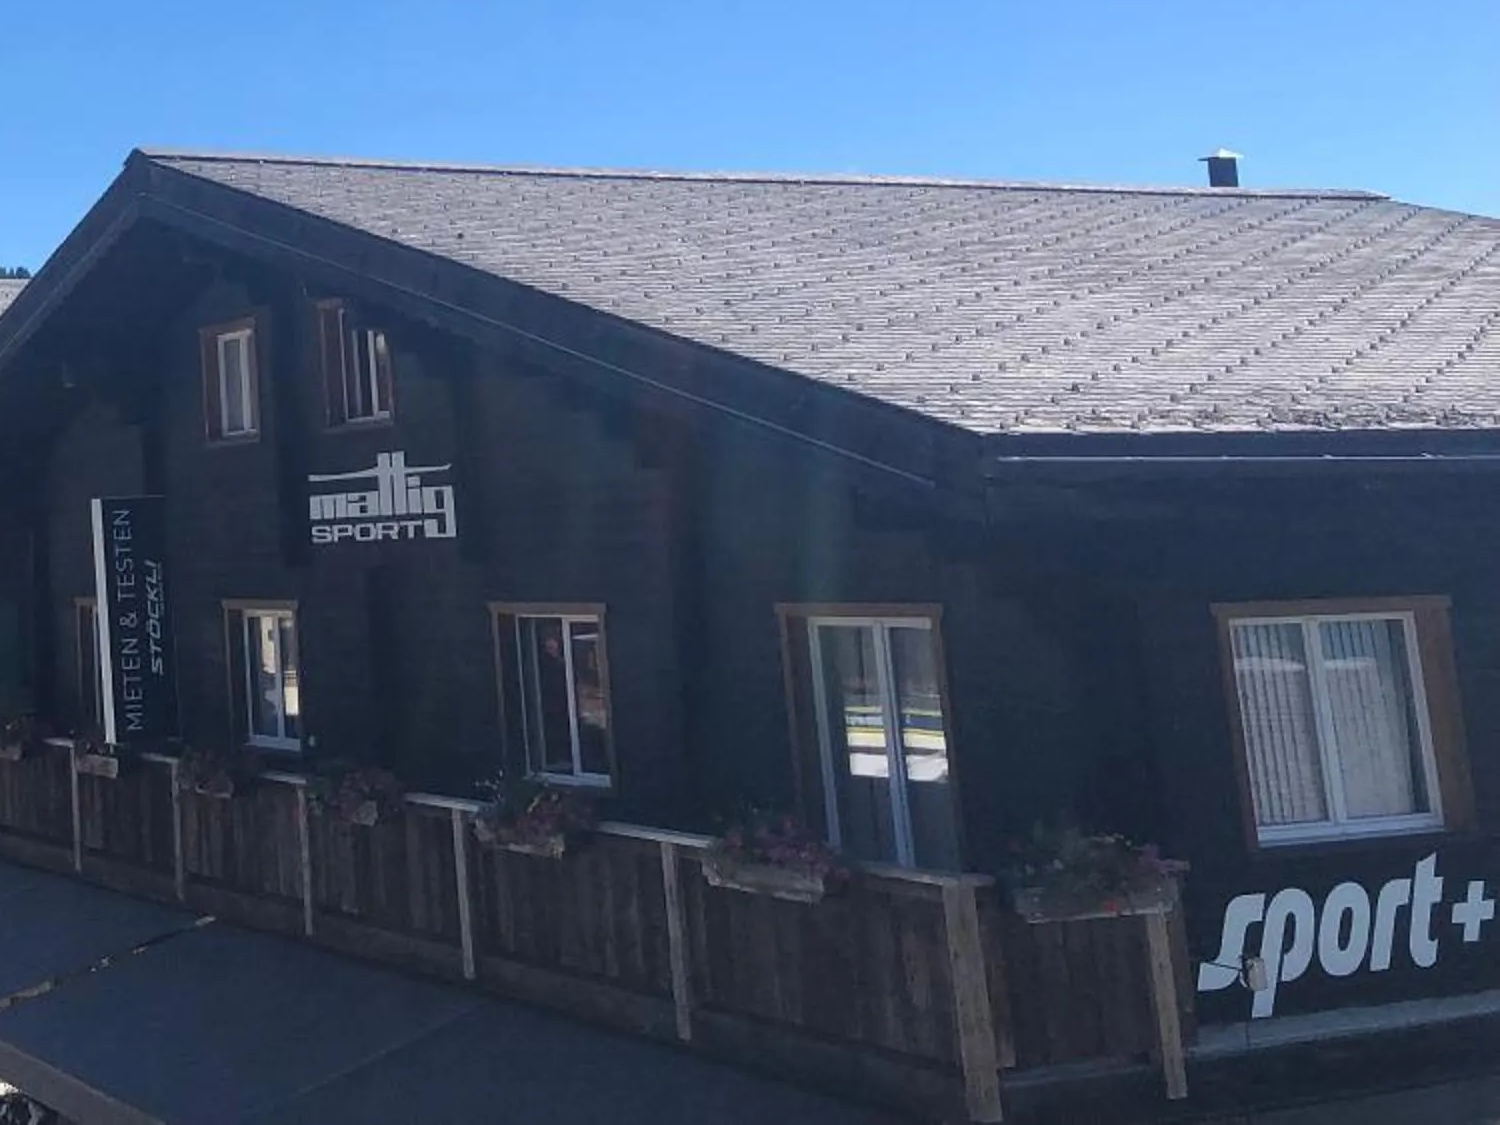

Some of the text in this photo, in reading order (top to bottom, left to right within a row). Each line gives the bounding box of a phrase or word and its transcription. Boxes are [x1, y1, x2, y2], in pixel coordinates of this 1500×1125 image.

[311, 520, 424, 544] SPORT
[112, 509, 144, 731] MIETEN & TESTEN
